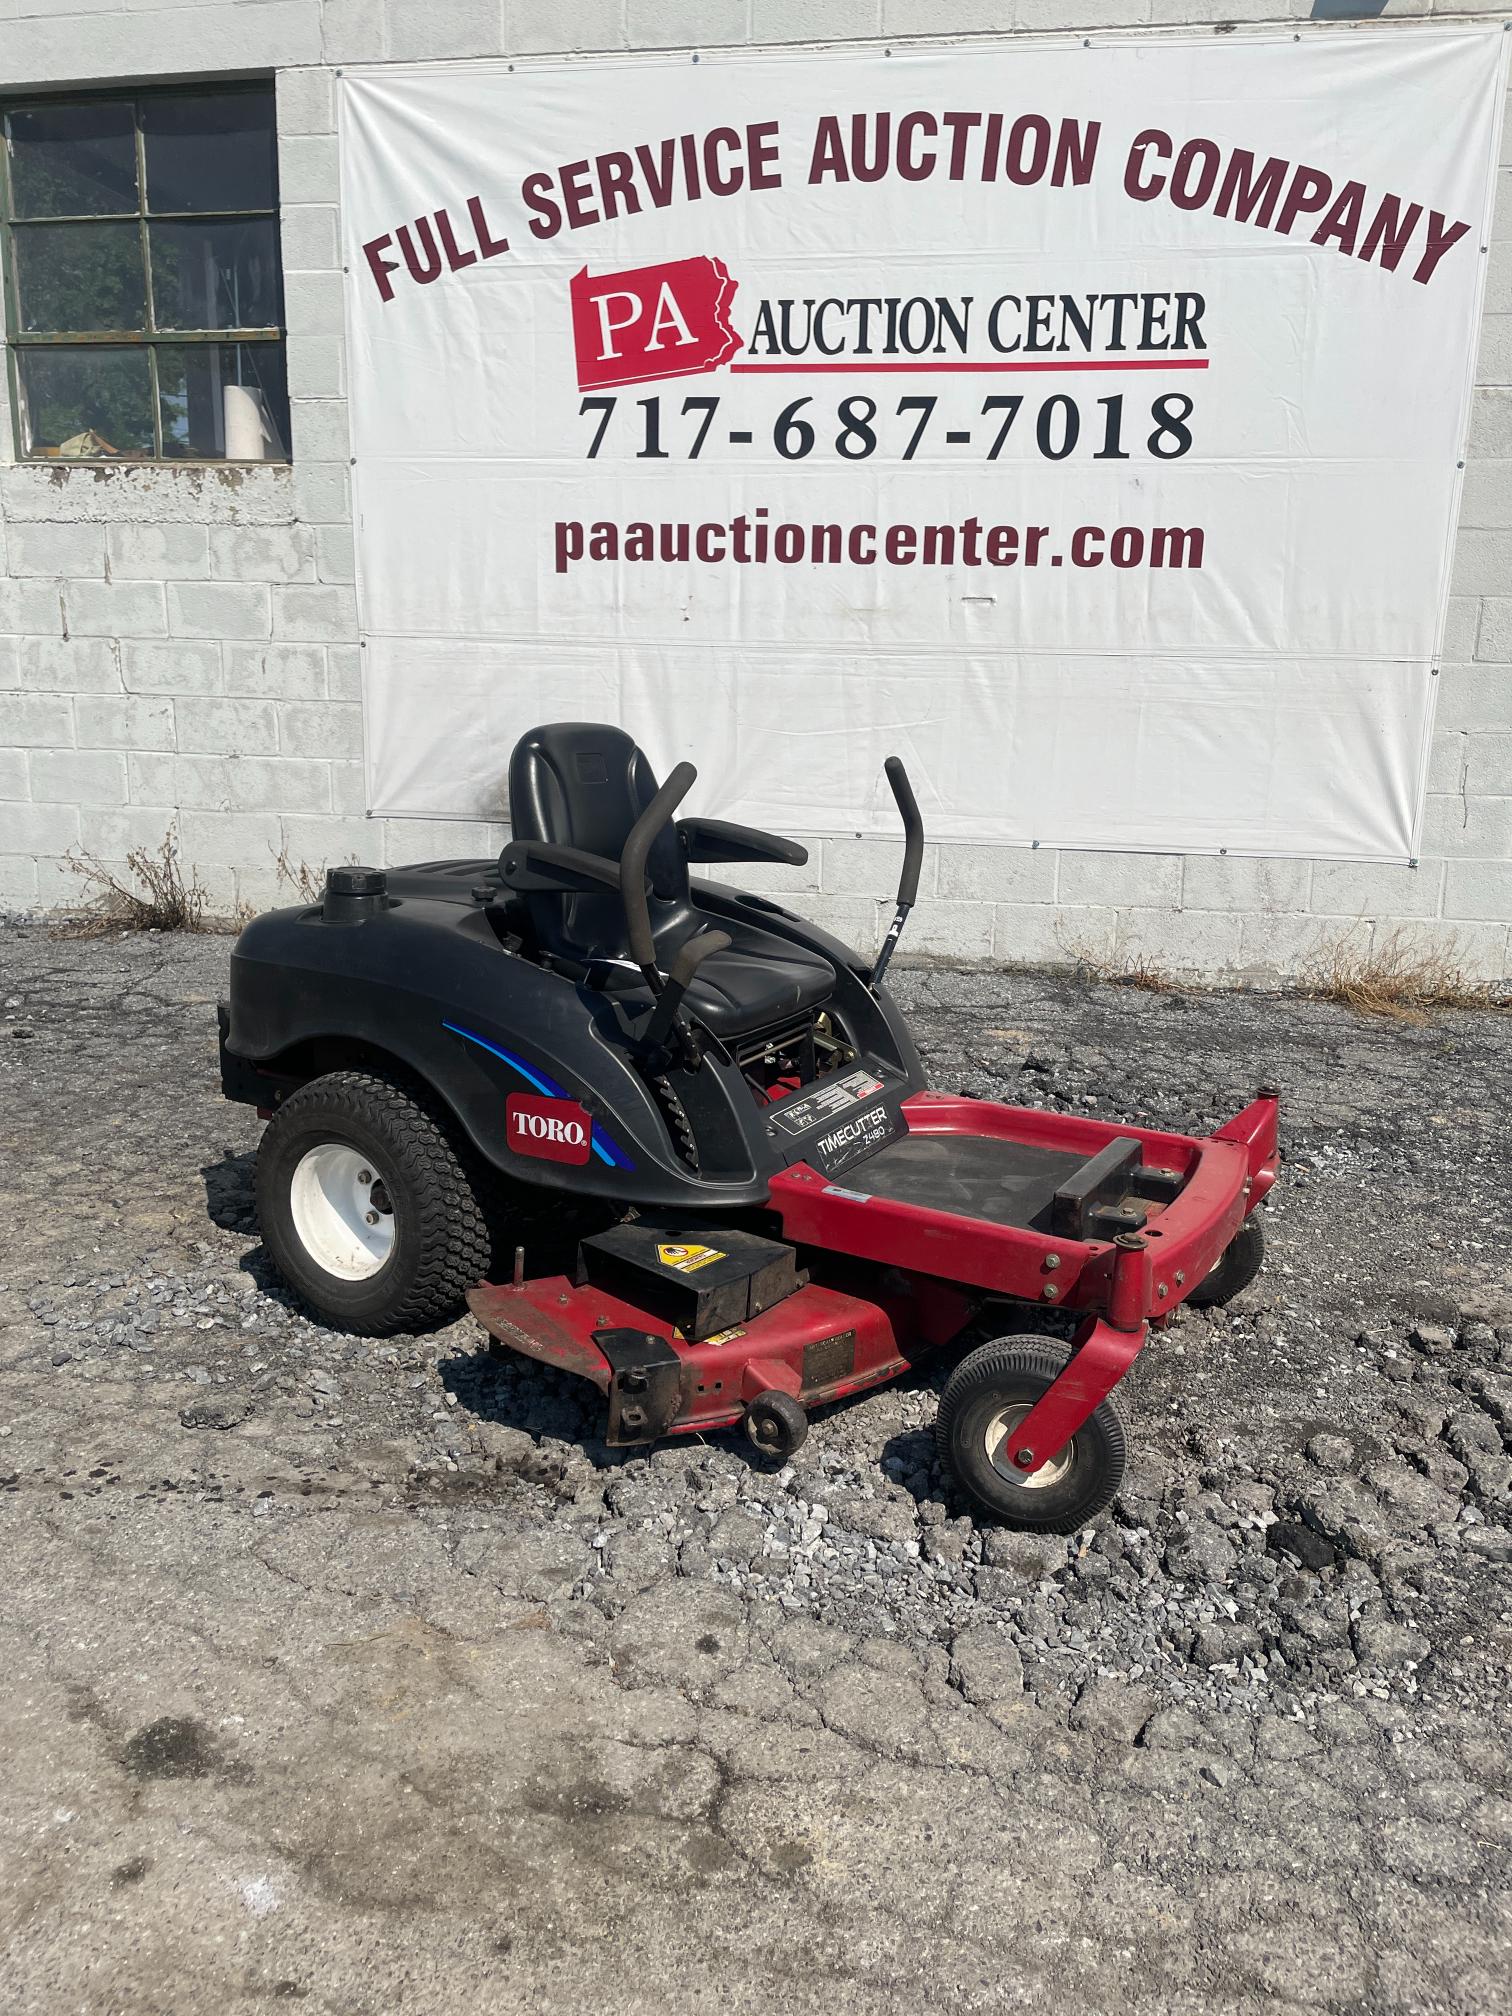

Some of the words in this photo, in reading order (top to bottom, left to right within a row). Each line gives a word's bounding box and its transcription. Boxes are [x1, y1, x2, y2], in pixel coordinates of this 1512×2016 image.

[362, 195, 510, 303] FULL
[521, 120, 782, 240] SERVICE
[807, 110, 1102, 188] AUCTION
[1123, 128, 1472, 285] COMPANY
[589, 281, 699, 361] PA
[747, 297, 974, 355] AUCTION
[987, 292, 1208, 354] CENTER
[578, 392, 1194, 461] 717-687-7018
[555, 507, 1205, 574] paauctioncenter.com
[512, 1111, 584, 1145] TORO
[817, 1106, 887, 1155] TIMECUTTER
